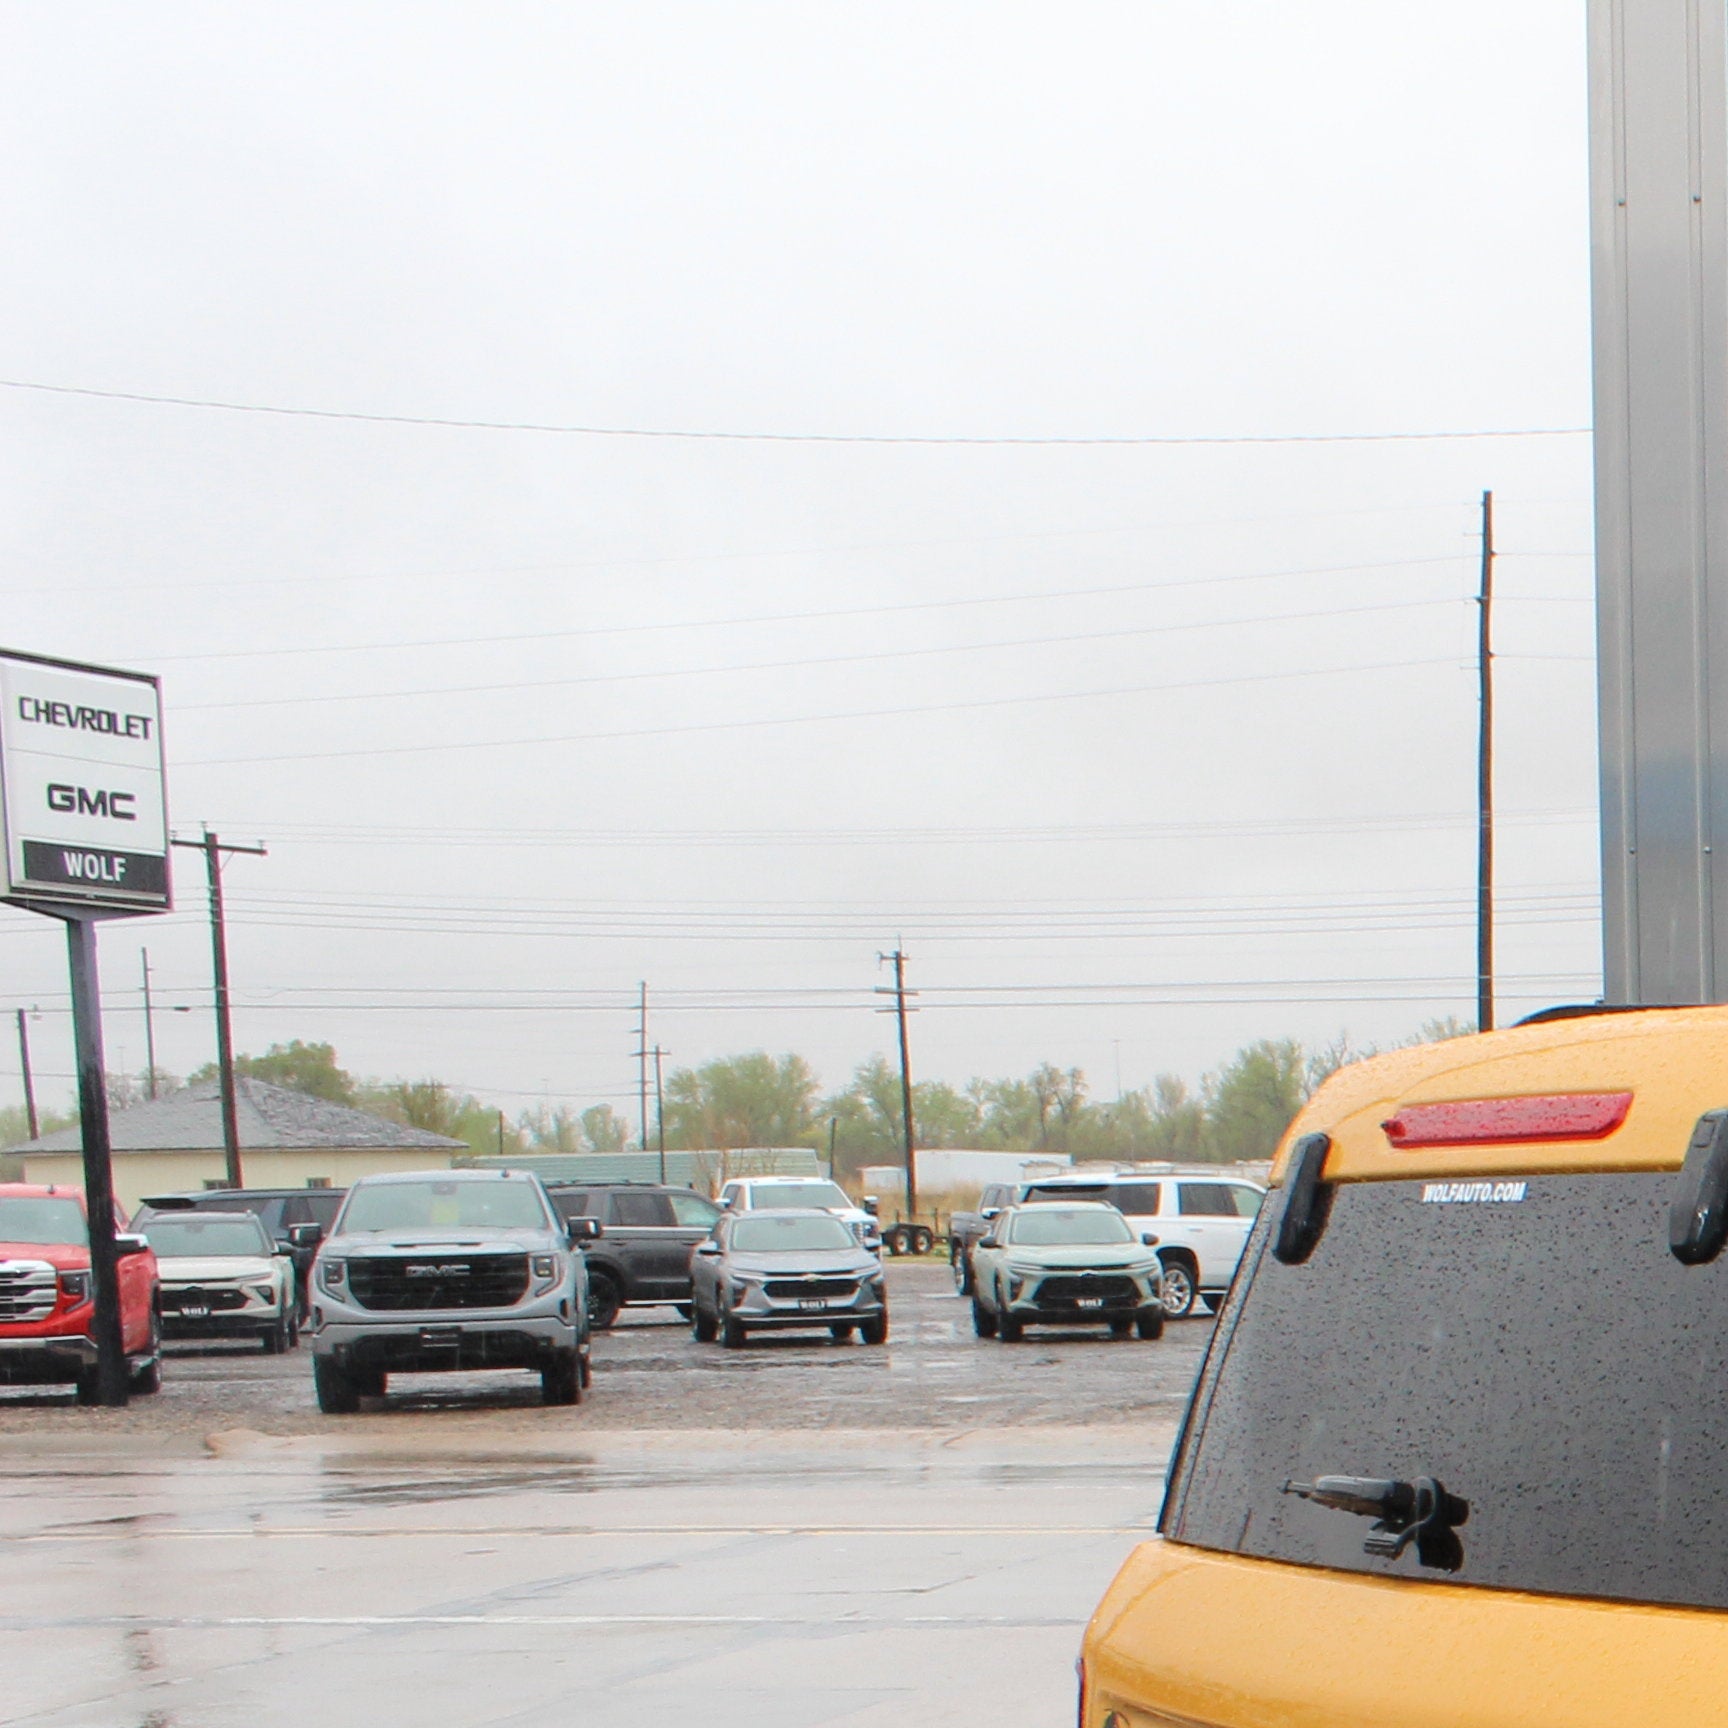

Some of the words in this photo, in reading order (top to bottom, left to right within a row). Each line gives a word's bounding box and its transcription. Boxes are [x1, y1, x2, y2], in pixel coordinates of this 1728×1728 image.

[19, 695, 152, 740] CHEVROLET
[48, 783, 136, 820] GMC
[63, 851, 126, 882] WOLF
[1423, 1182, 1527, 1202] WOLFAUTO.COM
